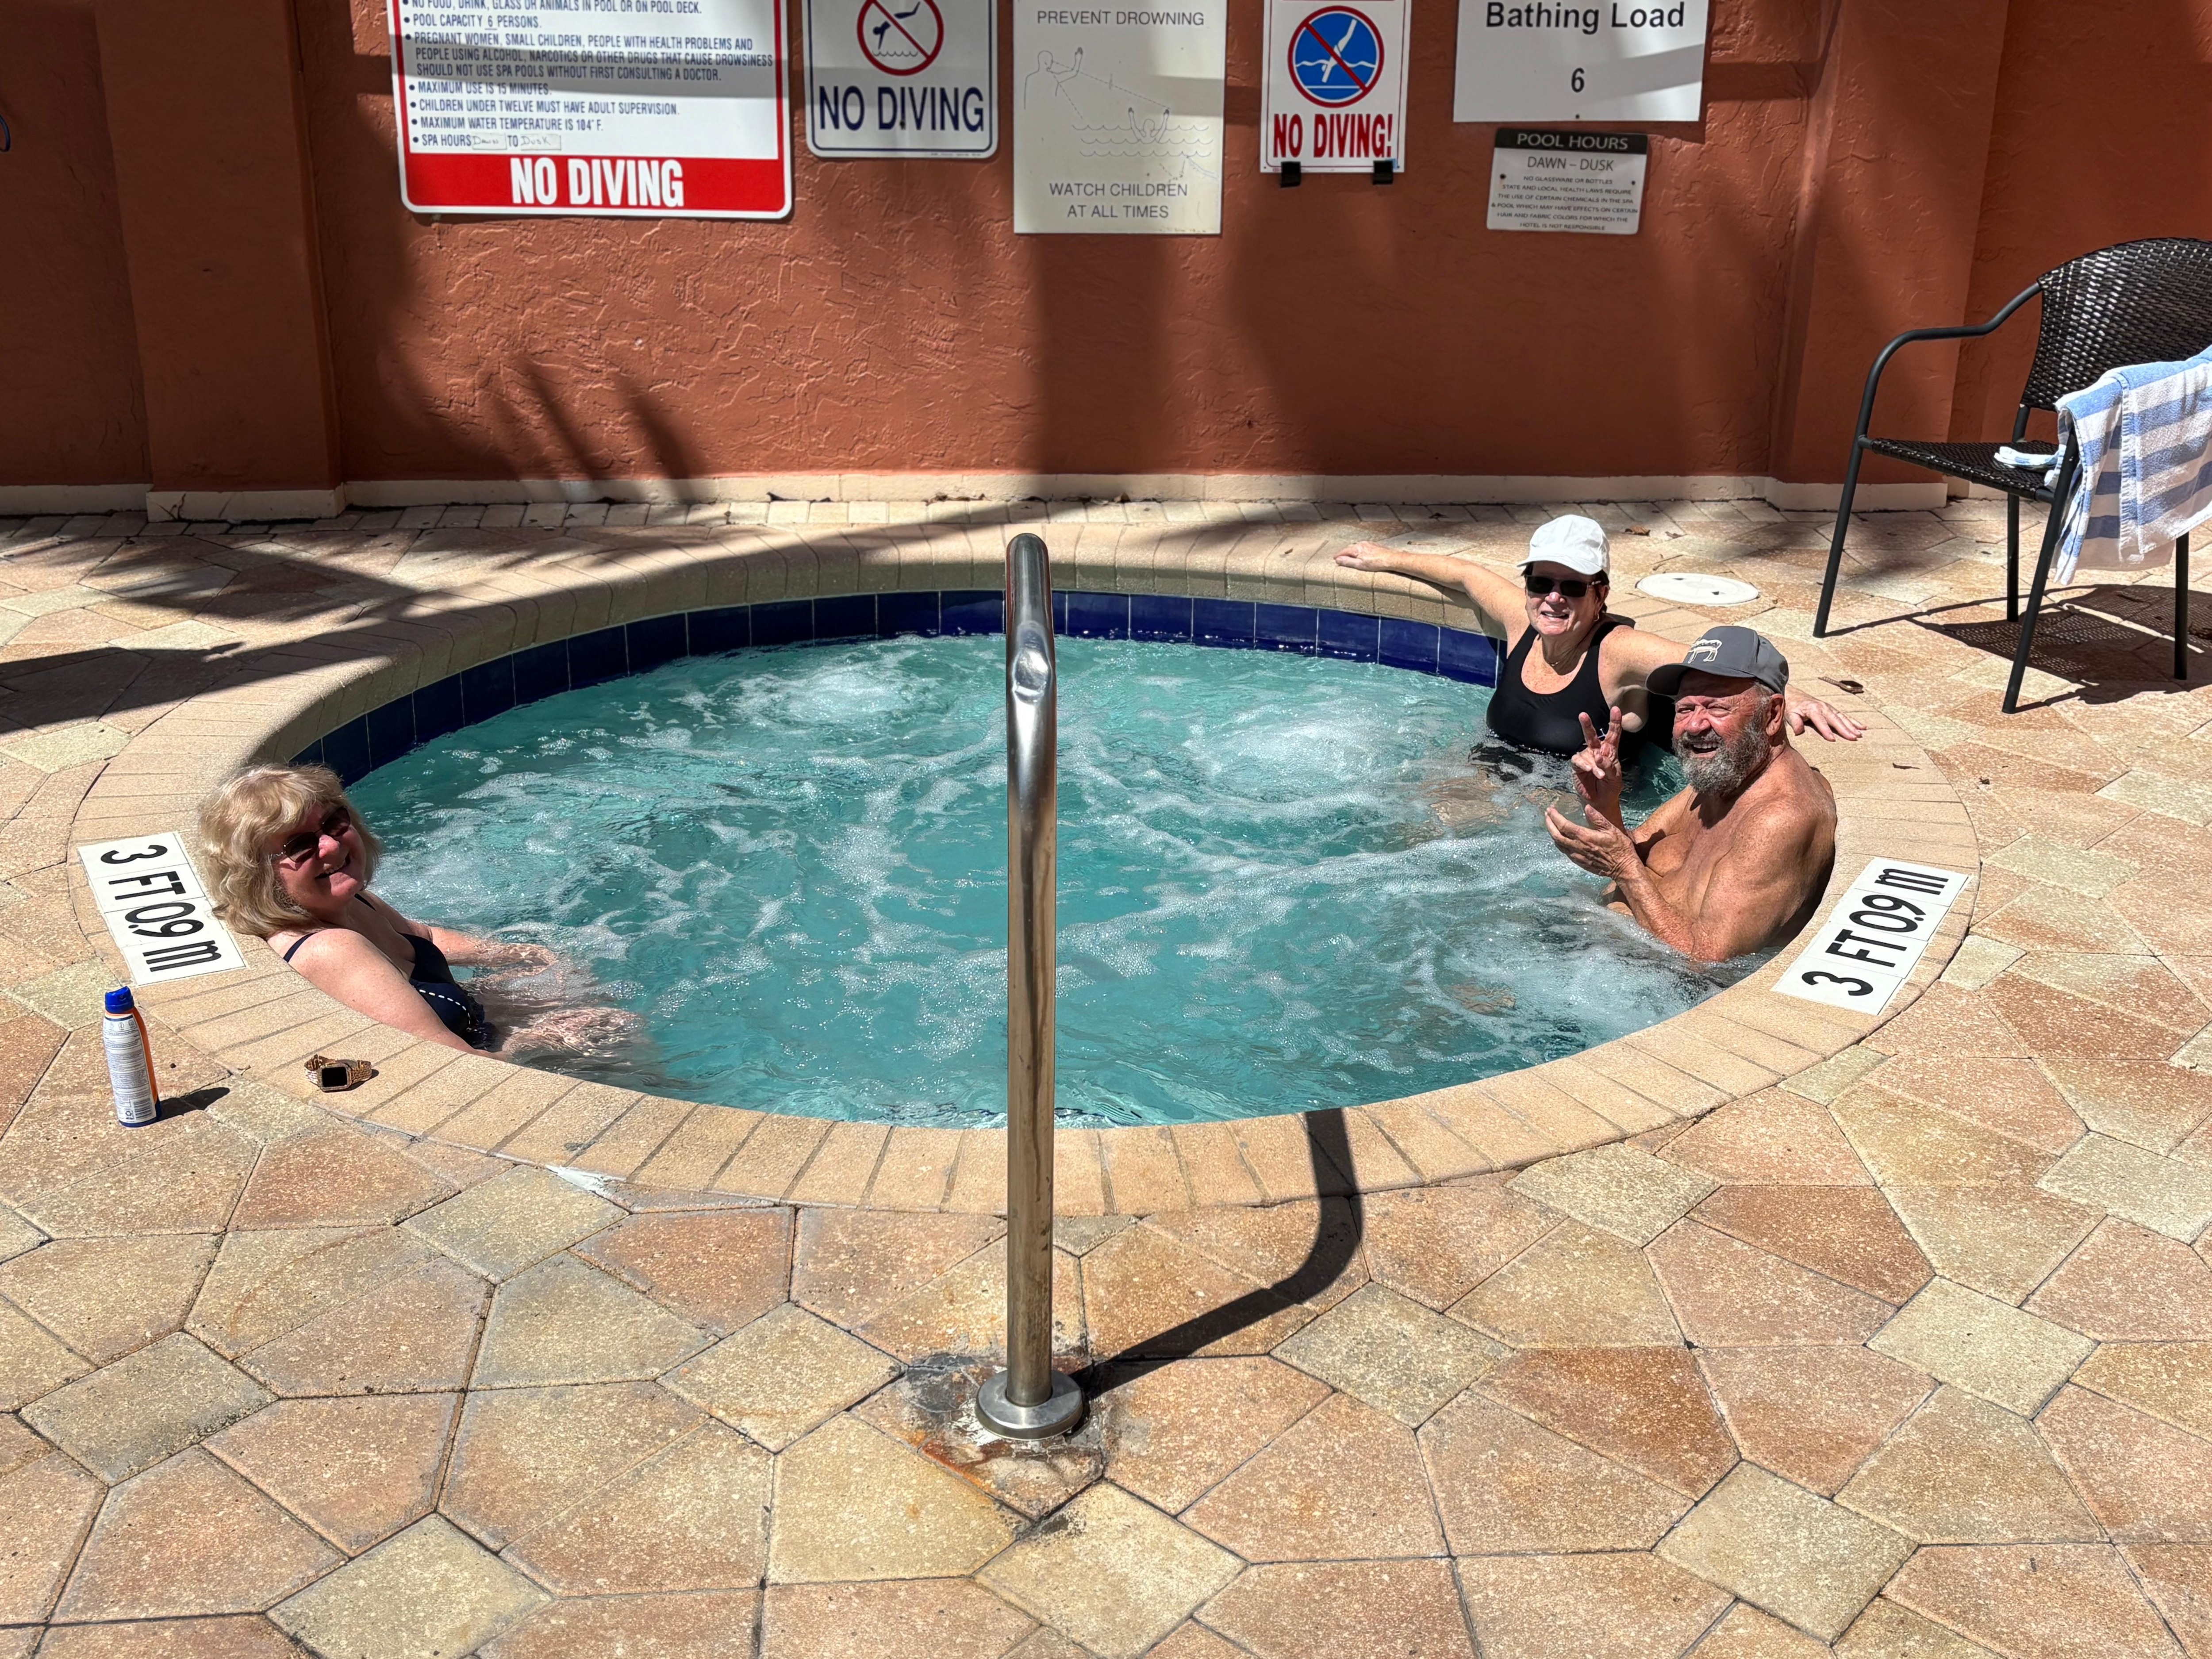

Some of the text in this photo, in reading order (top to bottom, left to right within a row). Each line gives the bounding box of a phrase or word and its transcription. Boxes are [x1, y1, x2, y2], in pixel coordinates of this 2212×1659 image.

[428, 0, 455, 10] FOOD,
[459, 0, 489, 11] DRINK,
[493, 0, 521, 10] GLASS
[525, 0, 537, 10] OR
[540, 0, 579, 11] ANIMALS
[583, 0, 591, 11] IN
[595, 0, 617, 12] POOL
[621, 0, 633, 12] OR
[636, 0, 648, 12] ON
[651, 0, 673, 13] POOL
[677, 1, 702, 14] DECK.
[414, 14, 541, 28] POOL CAPACITY 6 PERSONS.
[1038, 10, 1204, 25] PREVENT DROWNING
[1486, 1, 1684, 35] Bathing Load
[415, 32, 753, 50] PREGNANT WOMEN, SMALL CHILDREN, PEOPLE WITH HEALTH PROBLEMS AND
[416, 47, 772, 67] PEOPLE USING ALCOHOL, NARCOTICS OR OTHER DRUGS THAT CAUSE DROWSINESS
[417, 63, 721, 81] SHOULD NOT USE SPA POOLS WITHOUT FIRST CONSULTING A DOCTOR.
[1571, 68, 1585, 93] 6
[418, 81, 552, 95] MAXIMUM USE IS 15 MINUTES.
[420, 99, 680, 115] CHILDREN UNDER TWELVE MUST HAVE ADULT SUPERVISION.
[819, 85, 983, 132] NO DIVING
[421, 117, 465, 129] MAXIMUM
[468, 117, 496, 129] WATER
[499, 118, 562, 131] TEMPERATURE
[565, 119, 573, 131] IS
[422, 134, 438, 146] SPA
[441, 134, 471, 147] HOURS
[508, 135, 518, 147] TO
[1273, 113, 1393, 157] NO DIVING!
[1517, 133, 1628, 150] POOL HOURS
[1528, 157, 1566, 169] DAWN
[1580, 158, 1614, 171] DUSK
[510, 157, 684, 207] NO DIVING
[1049, 183, 1188, 196] WATCH CHILDREN
[1068, 205, 1169, 218] AT ALL TIMES
[100, 845, 168, 864] 3
[108, 870, 186, 901] FT
[1874, 868, 1949, 895] m
[142, 940, 221, 972] m
[1825, 929, 1907, 968] FT
[1801, 971, 1874, 996] 3
